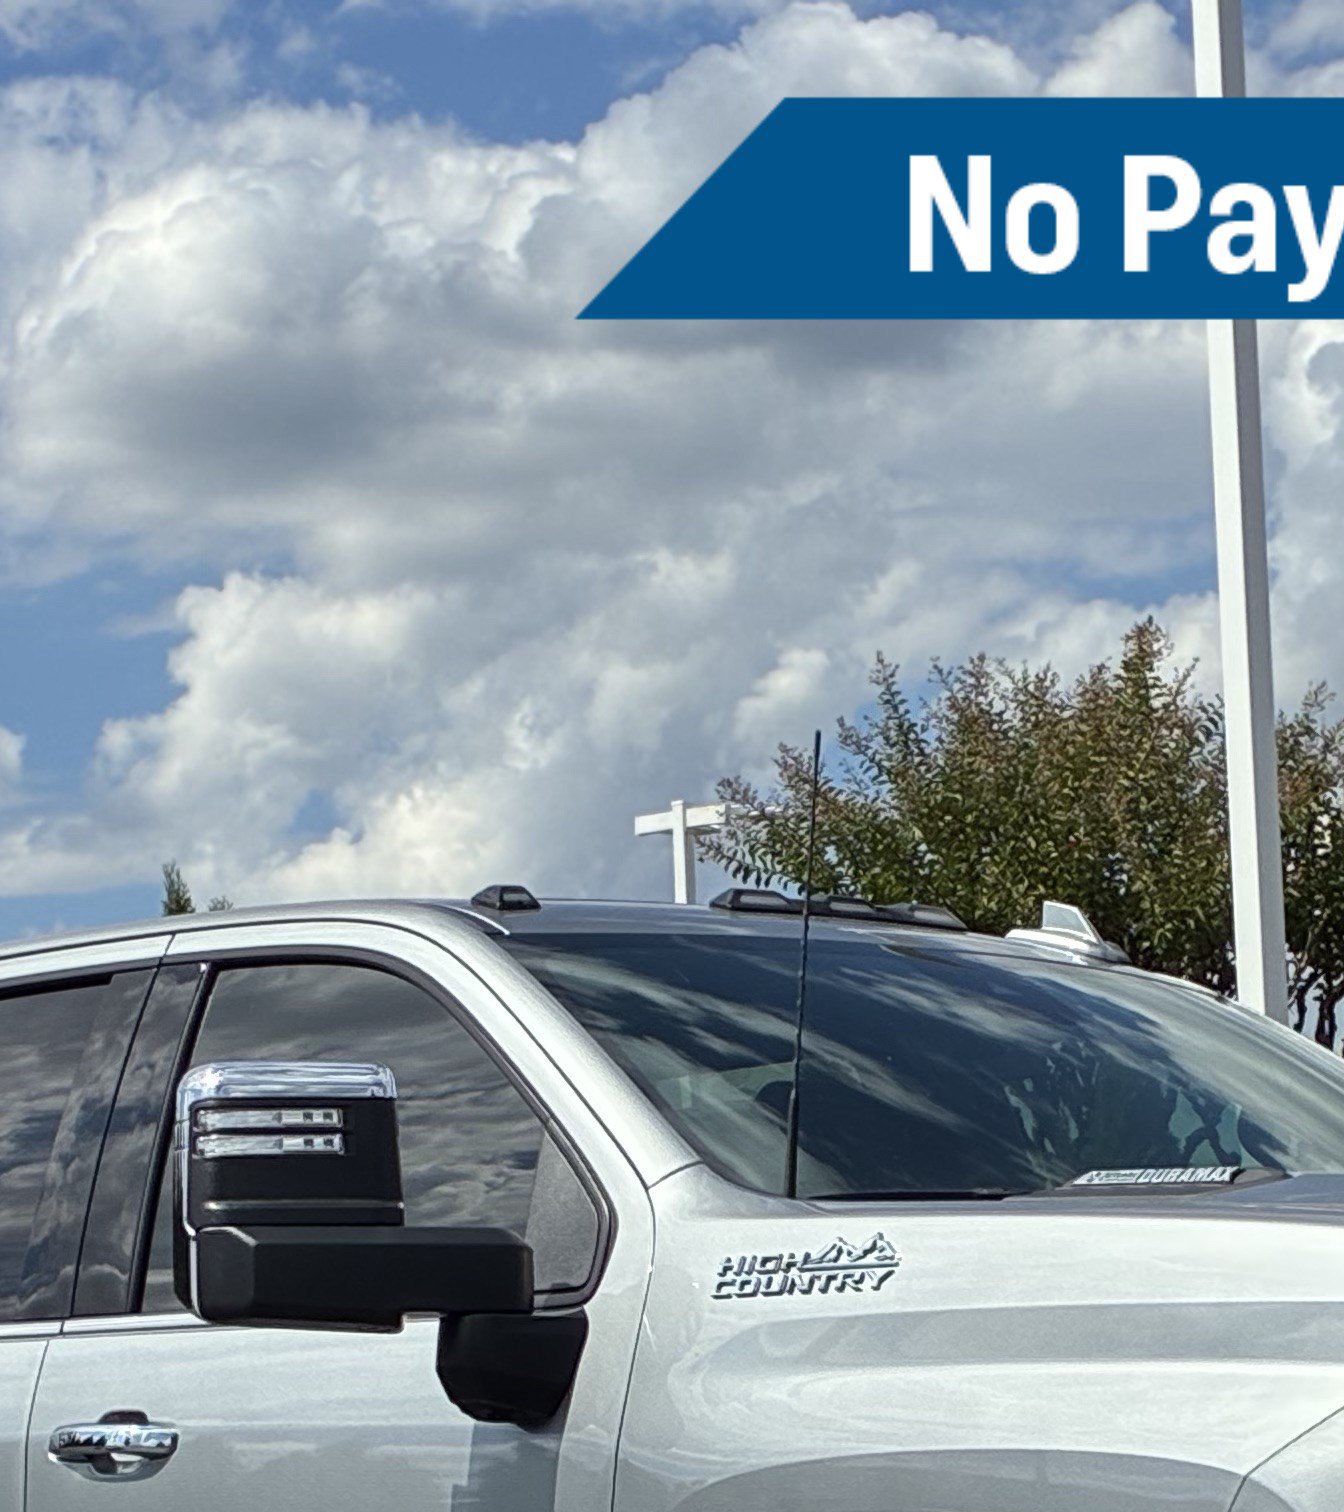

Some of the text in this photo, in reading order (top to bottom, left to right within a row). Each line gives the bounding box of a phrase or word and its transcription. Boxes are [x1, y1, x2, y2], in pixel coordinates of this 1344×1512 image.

[1136, 1166, 1240, 1183] DURAMAX
[717, 1251, 812, 1278] HIGH
[711, 1270, 895, 1300] COUNTRY
